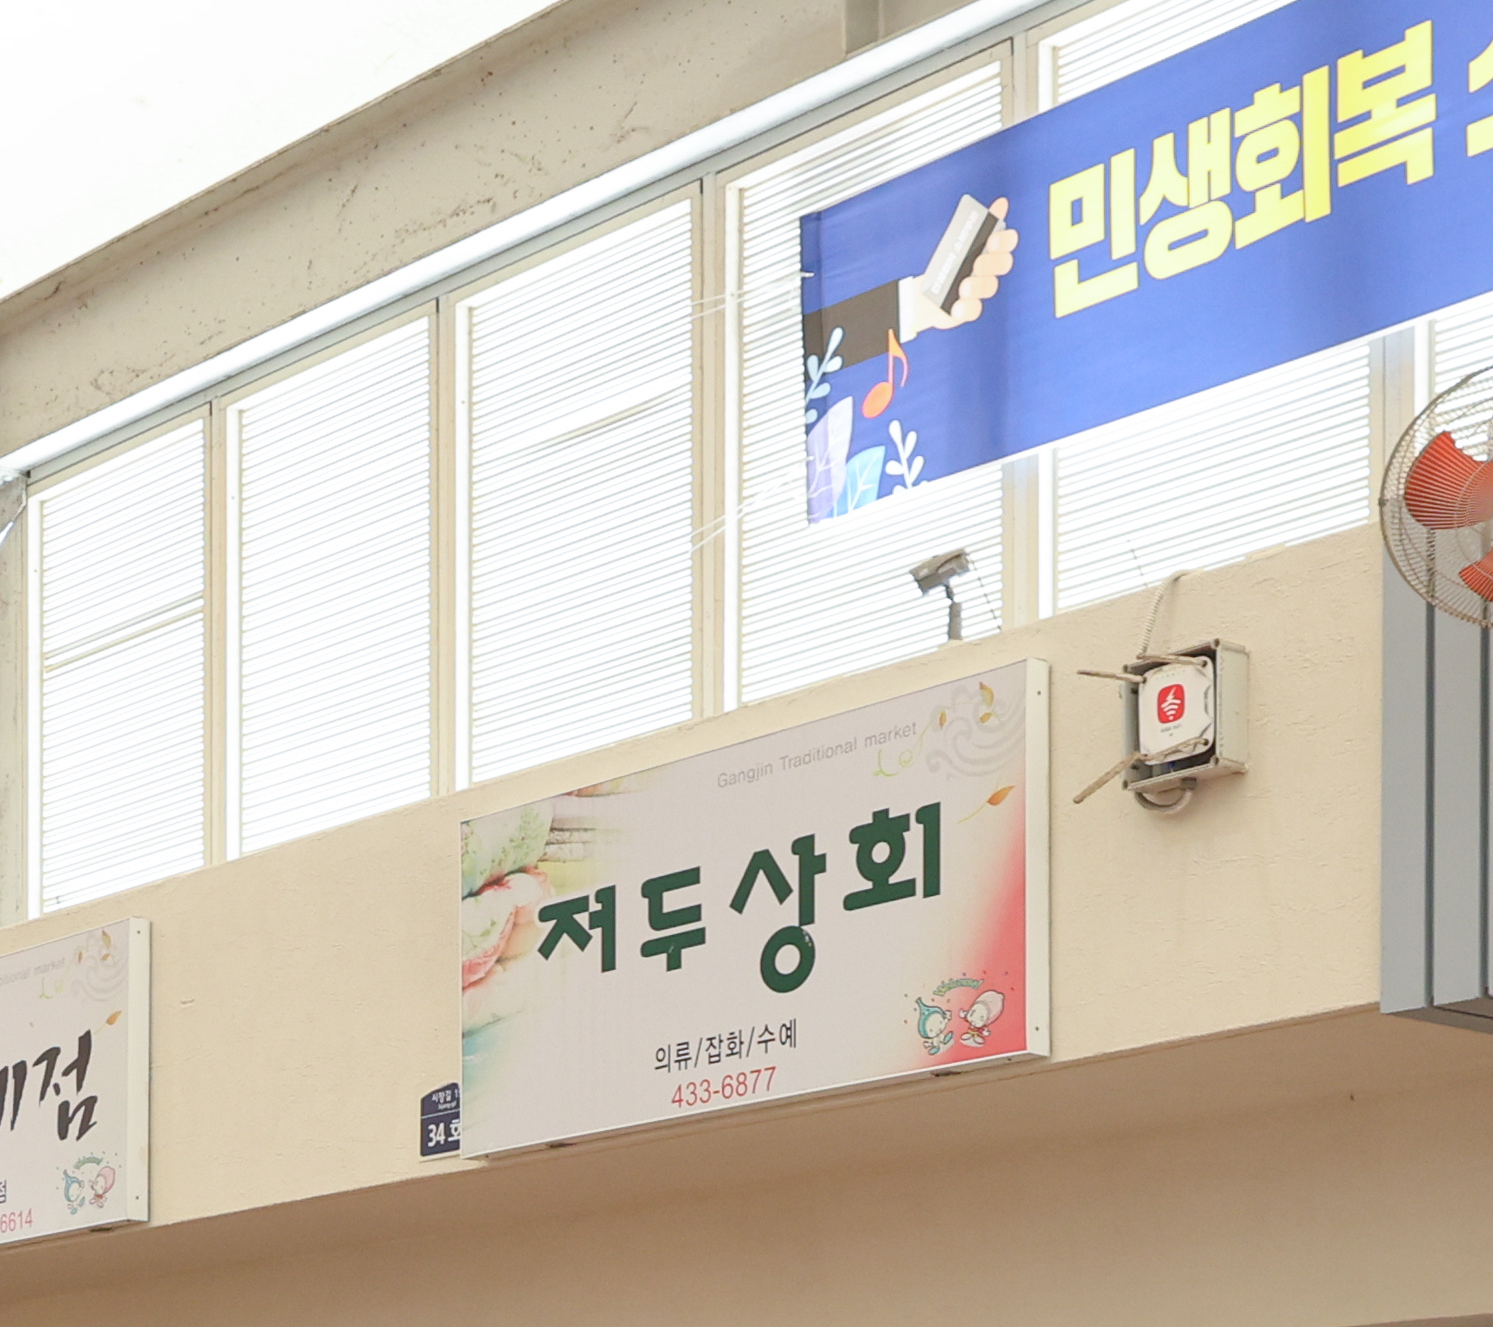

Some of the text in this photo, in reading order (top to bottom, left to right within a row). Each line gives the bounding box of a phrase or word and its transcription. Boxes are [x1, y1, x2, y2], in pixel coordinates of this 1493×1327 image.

[1048, 24, 1437, 319] 민생회복
[717, 722, 917, 788] Gangjin Traditional market
[538, 802, 941, 993] 저두상회
[654, 1018, 799, 1074] 의류/잡화/수예
[671, 1066, 776, 1109] 433-6877
[427, 1122, 446, 1147] 34
